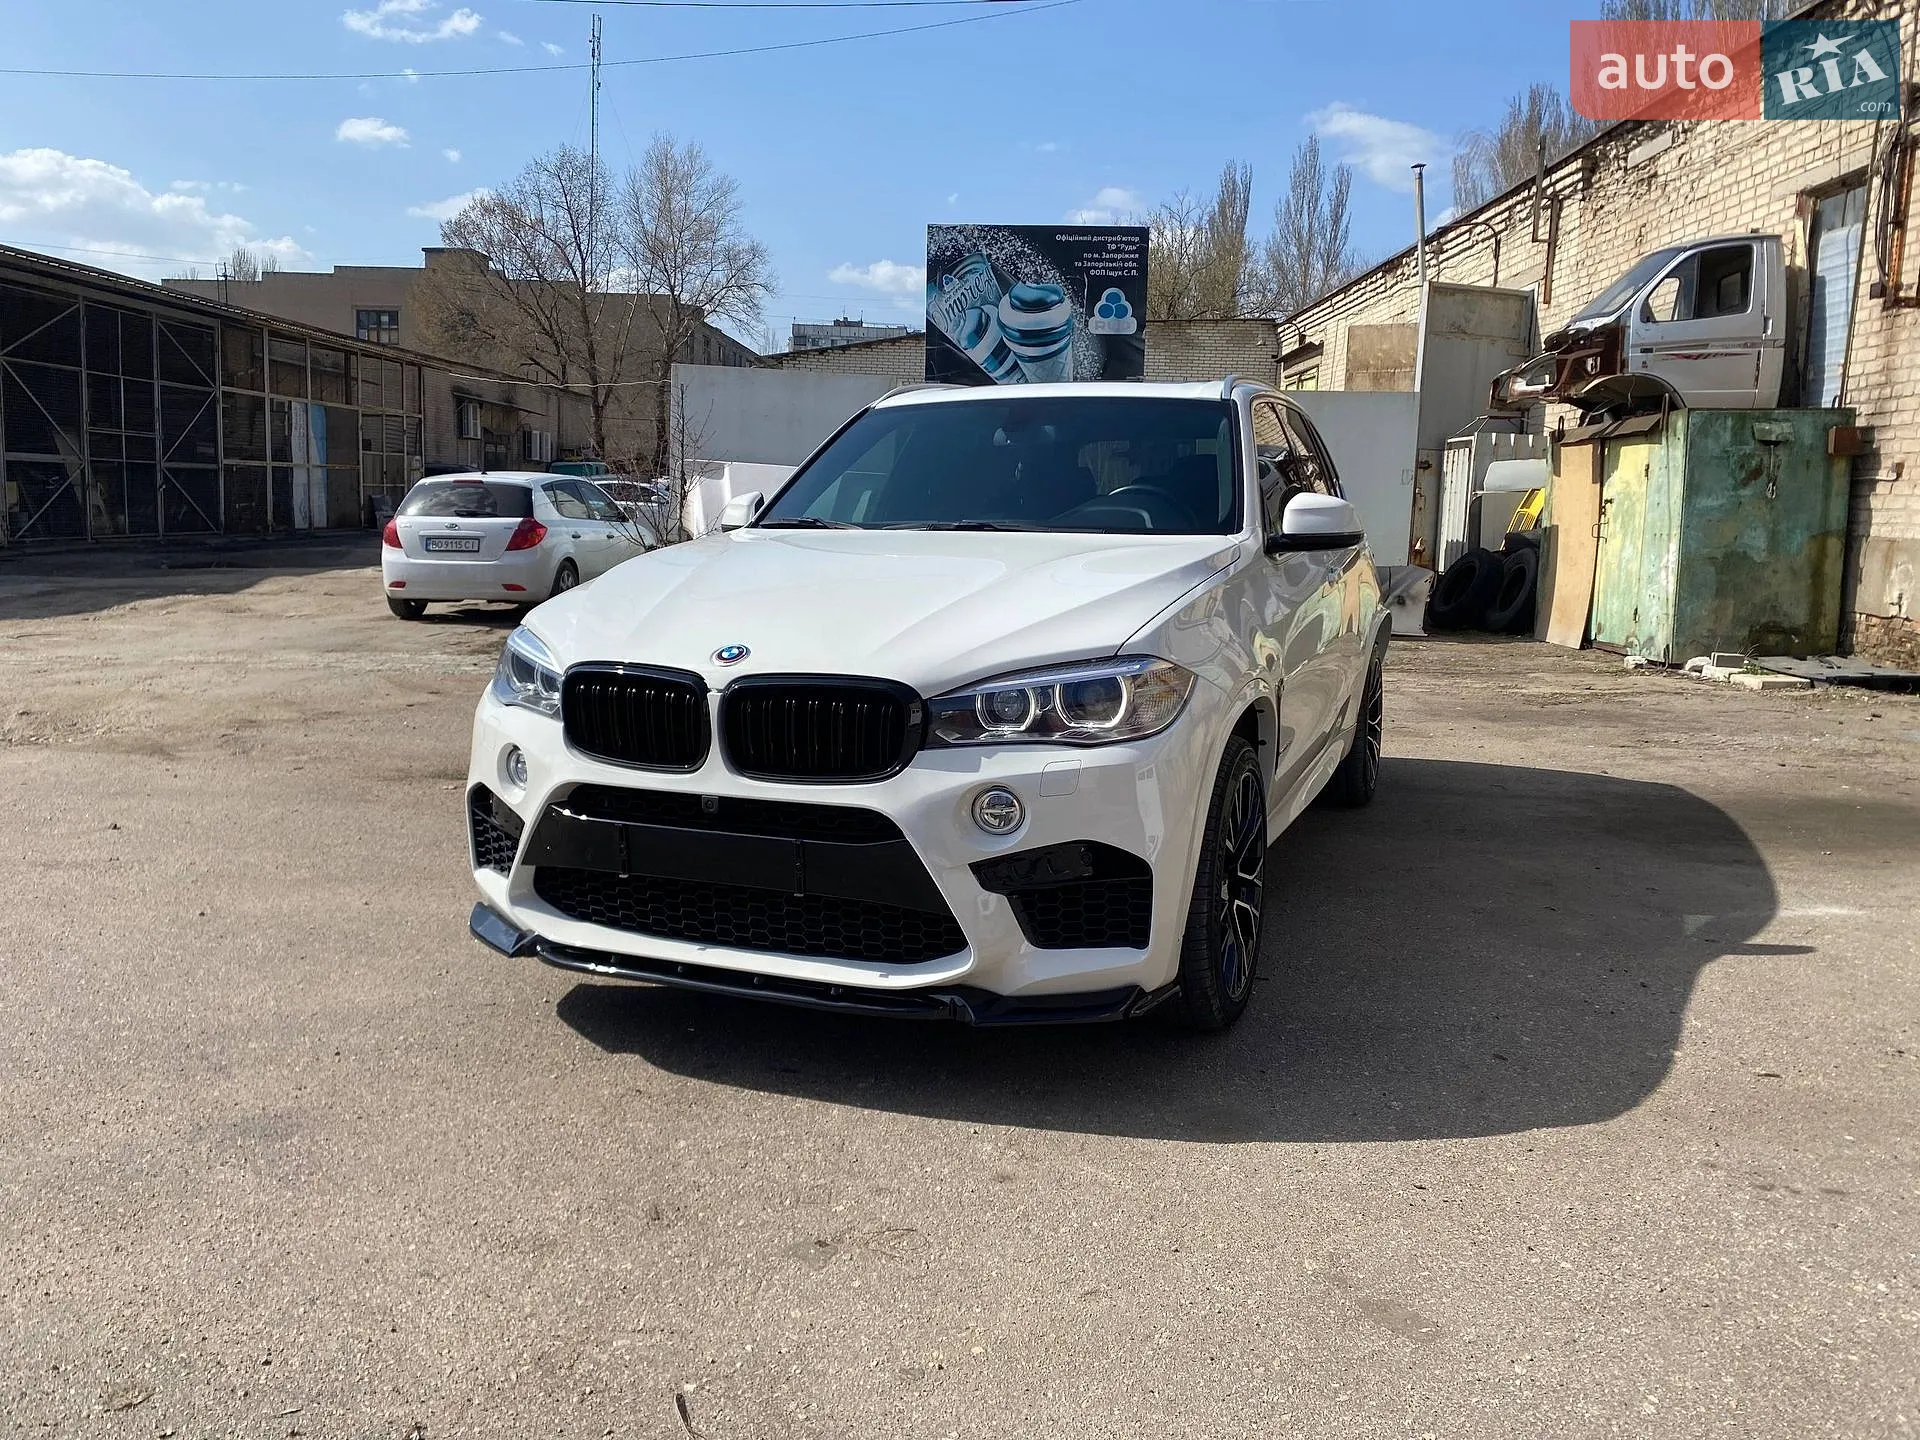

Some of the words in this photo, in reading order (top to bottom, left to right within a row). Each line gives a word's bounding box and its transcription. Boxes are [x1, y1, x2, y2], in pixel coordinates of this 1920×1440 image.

[1055, 234, 1092, 242] Офіційний
[1092, 235, 1140, 243] дистриб'ютор
[1107, 243, 1117, 251] ТФ
[1101, 252, 1139, 260] Запоріжжя
